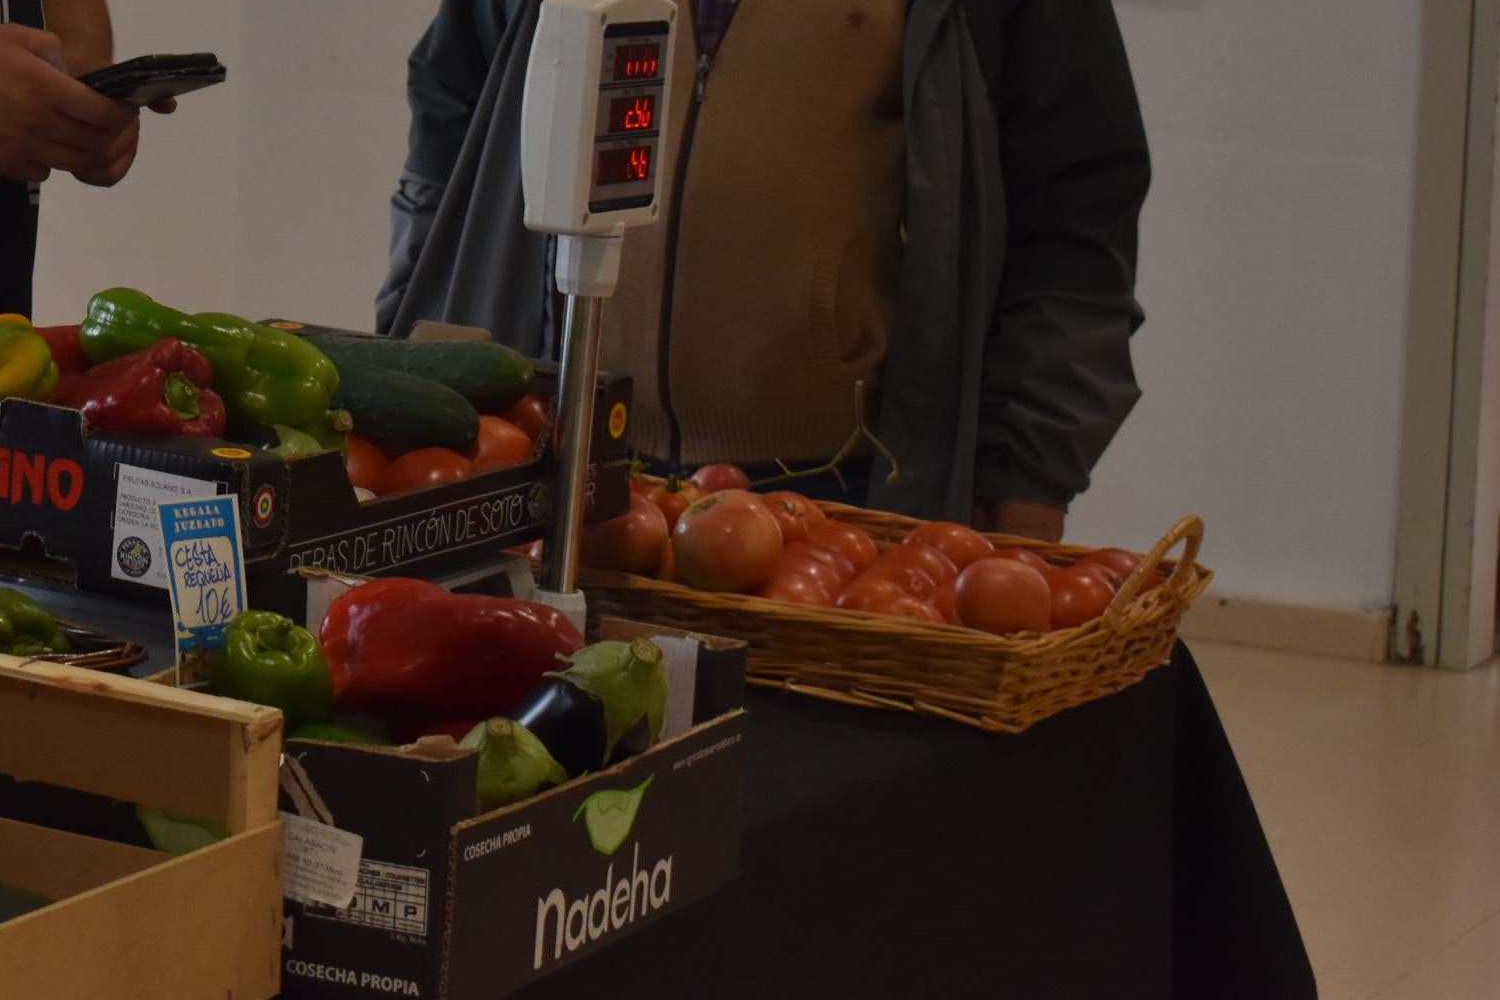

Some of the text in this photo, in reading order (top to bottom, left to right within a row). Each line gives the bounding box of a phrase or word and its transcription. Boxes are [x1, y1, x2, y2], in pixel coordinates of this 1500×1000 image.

[173, 504, 220, 519] REGALA
[290, 493, 525, 573] PERAS DE RINCÓN DE SOTO
[196, 587, 233, 624] 10€
[463, 823, 532, 861] COSECHA PROPIA
[372, 899, 417, 918] M P
[286, 959, 420, 998] COSECHA PROPIA
